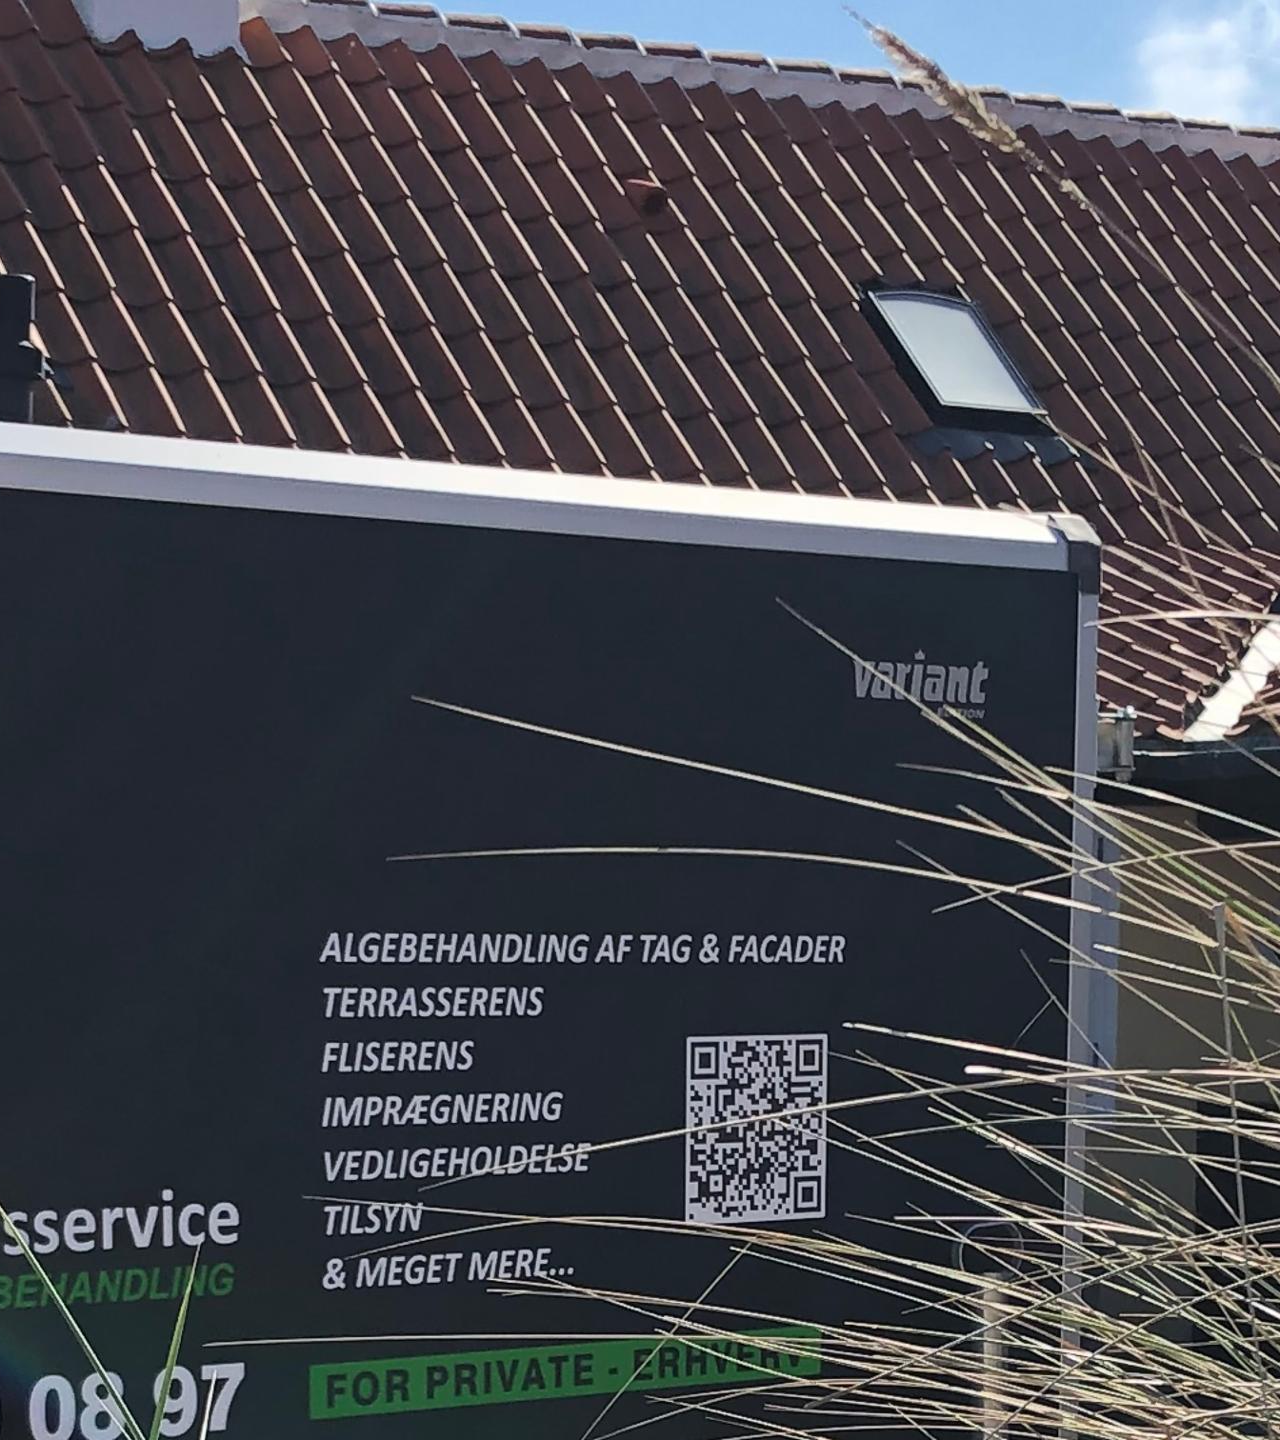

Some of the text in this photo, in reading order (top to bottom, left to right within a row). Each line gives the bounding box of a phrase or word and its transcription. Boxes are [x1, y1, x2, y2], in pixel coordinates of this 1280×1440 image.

[319, 932, 846, 964] ALGEBEHANDLING AF TAG & FACADER
[323, 986, 545, 1019] TERRASSERENS
[322, 1041, 475, 1073] FLISERENS
[322, 1091, 564, 1128] IMPRÆGNERING
[323, 1142, 592, 1182] VEDLIGEHOLDELSE
[323, 1202, 424, 1236] TILSYN
[322, 1247, 574, 1289] & MEGET MERE...
[326, 1368, 410, 1408] FOR
[426, 1353, 594, 1399] PRIVATE
[153, 1362, 245, 1437] 97
